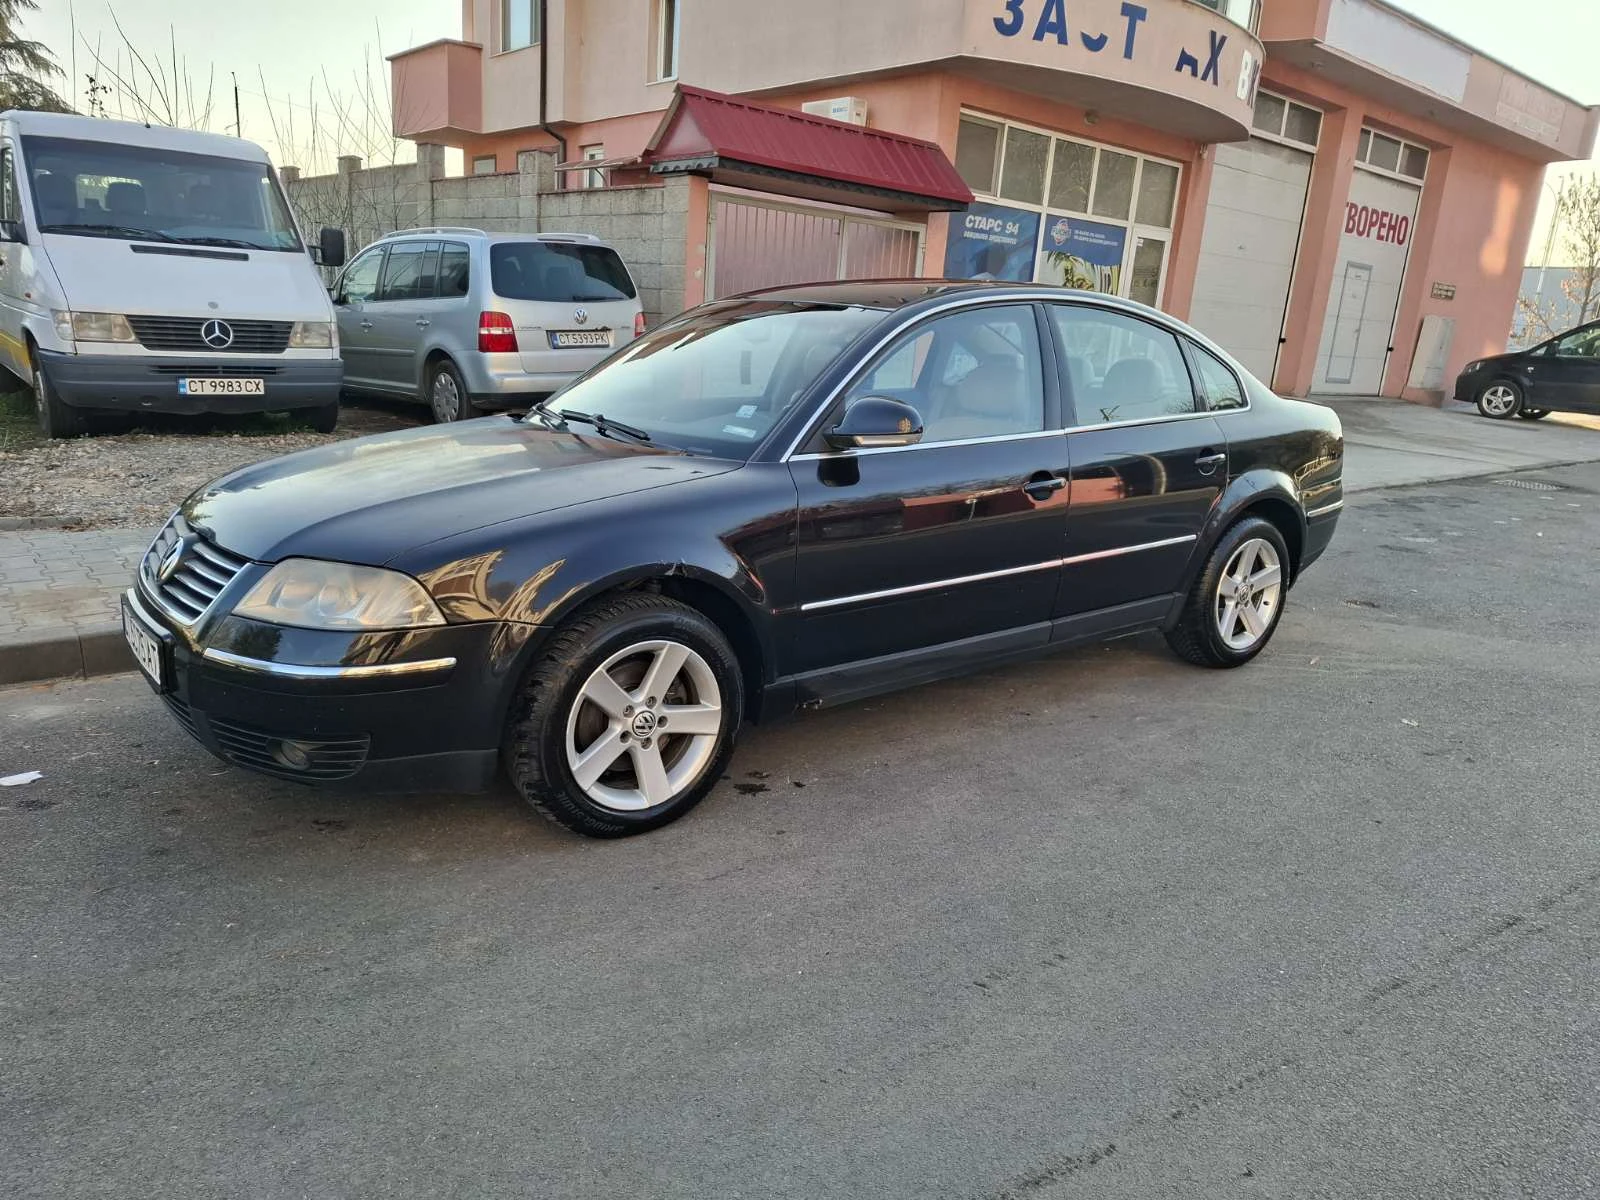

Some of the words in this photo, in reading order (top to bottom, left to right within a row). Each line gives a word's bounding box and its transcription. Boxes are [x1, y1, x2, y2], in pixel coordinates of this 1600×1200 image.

[965, 214, 1003, 232] СТАРС
[1005, 221, 1020, 235] 94
[1345, 202, 1409, 246] ВОРЕНО
[188, 380, 206, 393] CT
[209, 380, 242, 393] 9983
[244, 380, 262, 393] CX
